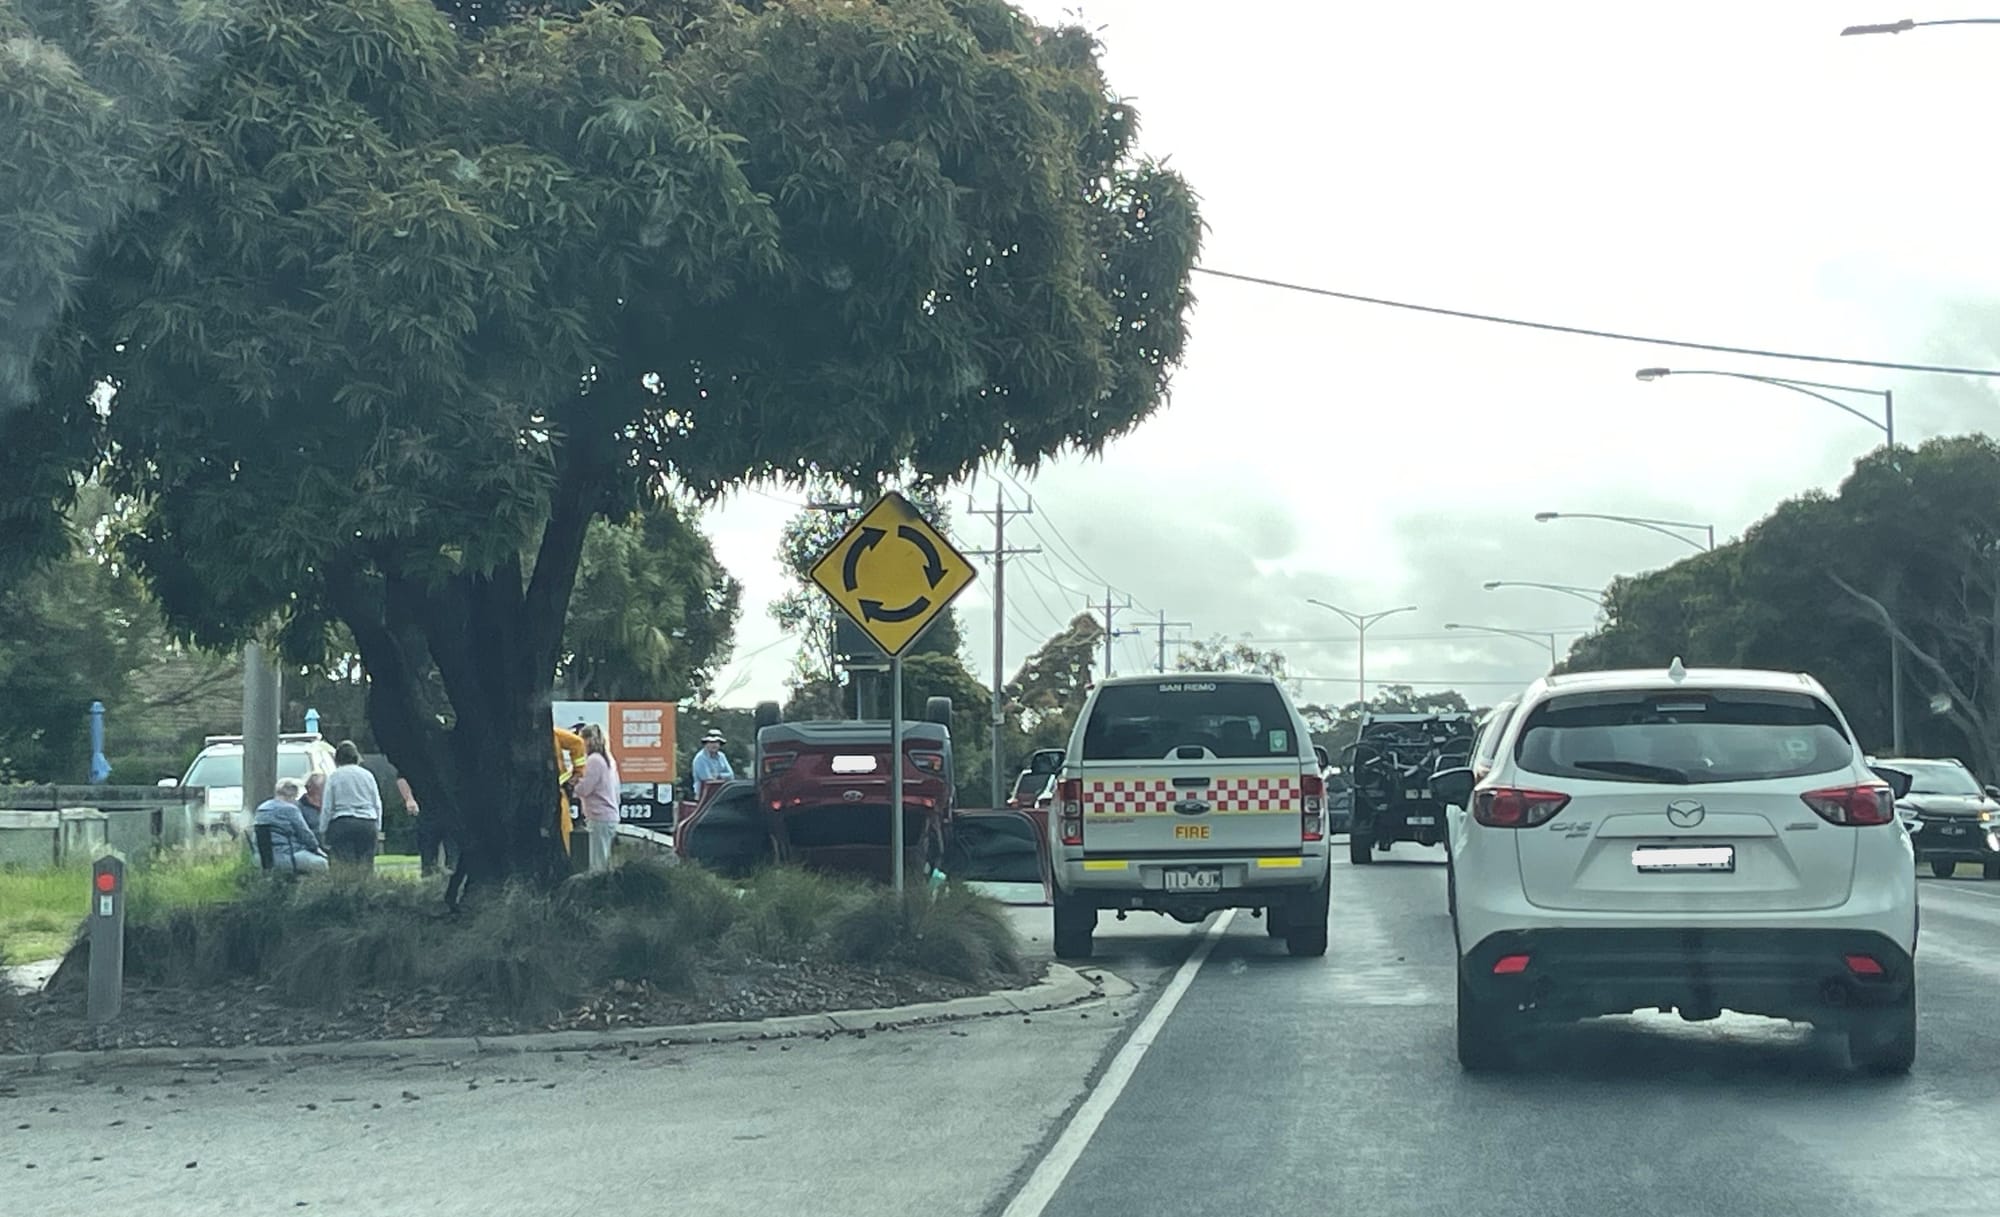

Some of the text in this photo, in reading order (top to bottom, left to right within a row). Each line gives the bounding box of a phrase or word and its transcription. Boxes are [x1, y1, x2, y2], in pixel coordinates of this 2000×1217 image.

[1159, 683, 1217, 692] SAN REMO
[1174, 825, 1210, 839] FIRE
